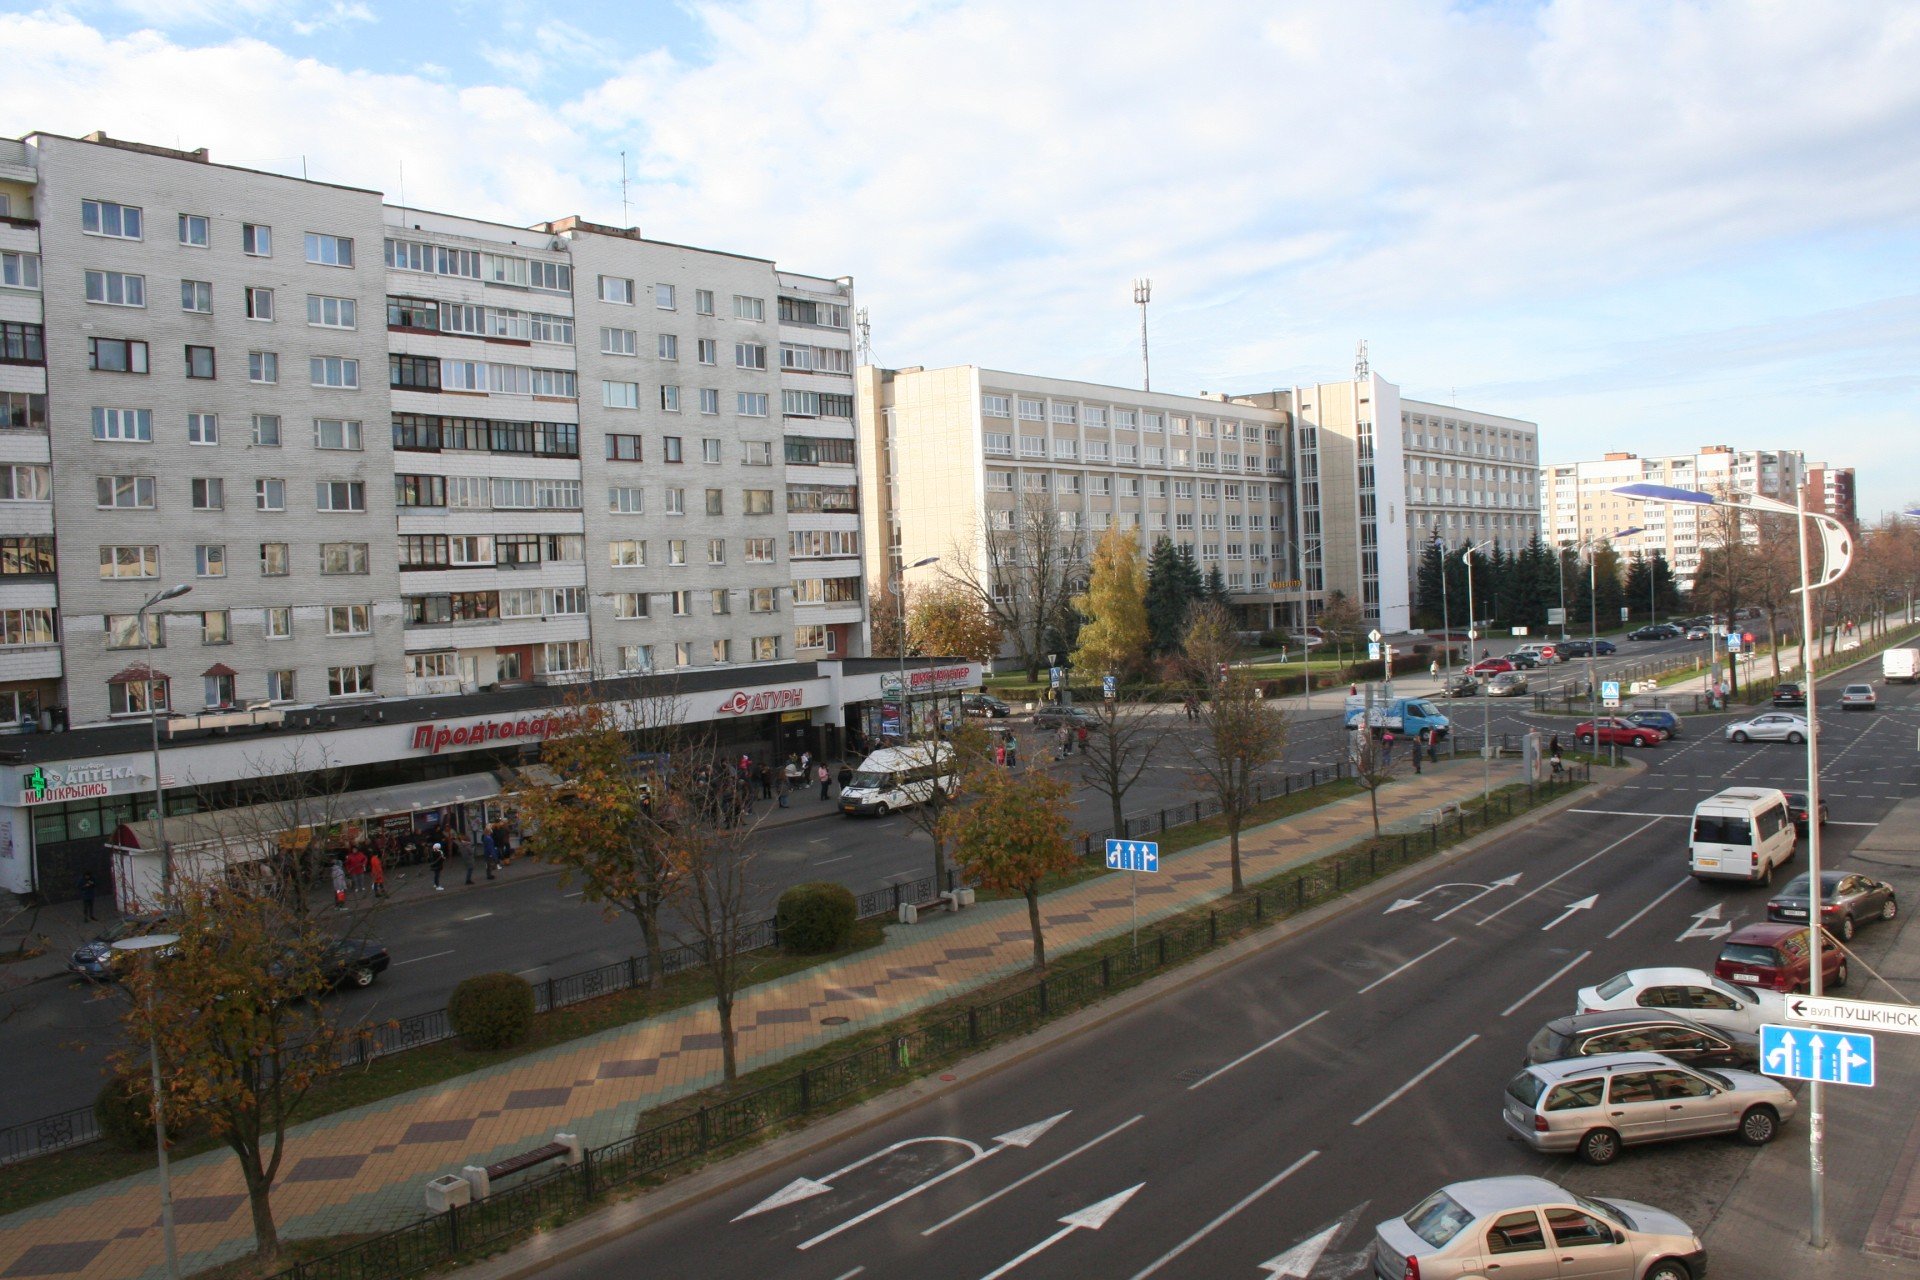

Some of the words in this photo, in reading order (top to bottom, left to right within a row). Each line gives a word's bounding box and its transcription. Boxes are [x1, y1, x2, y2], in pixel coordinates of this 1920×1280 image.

[911, 667, 970, 686] ДИСАУНТЕР
[731, 688, 803, 715] САТУРН
[413, 709, 580, 754] Продтовар
[65, 767, 136, 785] АПТЕКА
[46, 783, 108, 801] ОТКРЫЛИСЬ
[1834, 1006, 1918, 1026] ПУШКІНСК
